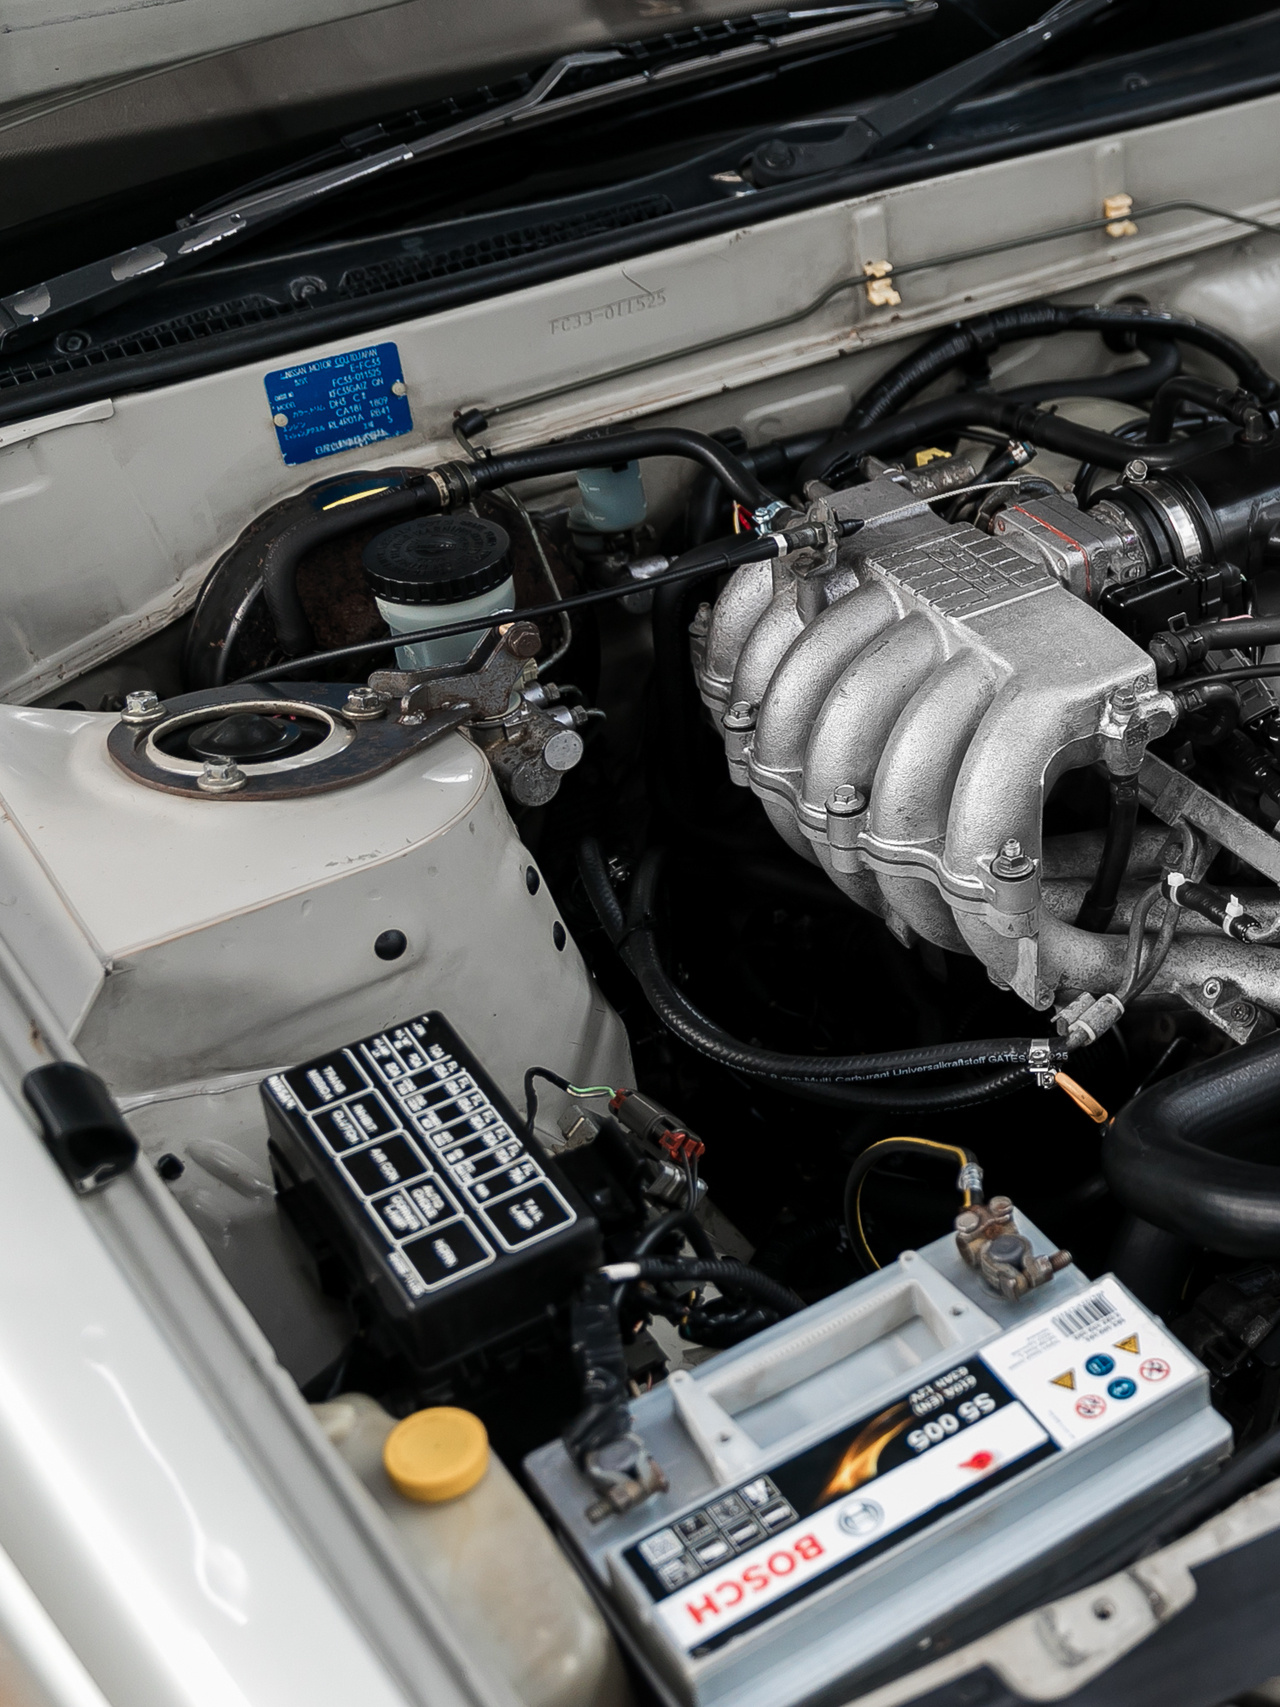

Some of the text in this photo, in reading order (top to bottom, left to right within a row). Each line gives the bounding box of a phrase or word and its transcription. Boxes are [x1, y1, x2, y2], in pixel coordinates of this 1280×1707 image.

[548, 288, 666, 334] FC33-011525
[283, 366, 306, 378] NISSAN
[308, 360, 332, 372] MOTOR
[331, 367, 382, 387] FC33-011525
[349, 357, 381, 372] E-FC33
[323, 1066, 345, 1093] TRANS
[834, 1069, 890, 1084] Carburant
[892, 1055, 986, 1077] Universalkraftstoff
[987, 1052, 1026, 1064] GATES
[268, 1075, 295, 1110] NISSAN
[307, 1068, 332, 1100] MISSION
[331, 1109, 359, 1143] CLUTCH
[353, 1103, 376, 1132] INHIBIT
[423, 1183, 444, 1210] AUTO
[523, 1198, 544, 1222] TAIL
[390, 1193, 420, 1231] CORNER
[509, 1204, 533, 1229] LAMP
[432, 1237, 457, 1268] HORN
[906, 1383, 934, 1405] 12V
[910, 1390, 946, 1419] (EN)
[954, 1388, 998, 1425] S5
[903, 1409, 962, 1456] 005
[684, 1532, 825, 1626] BOSCH
